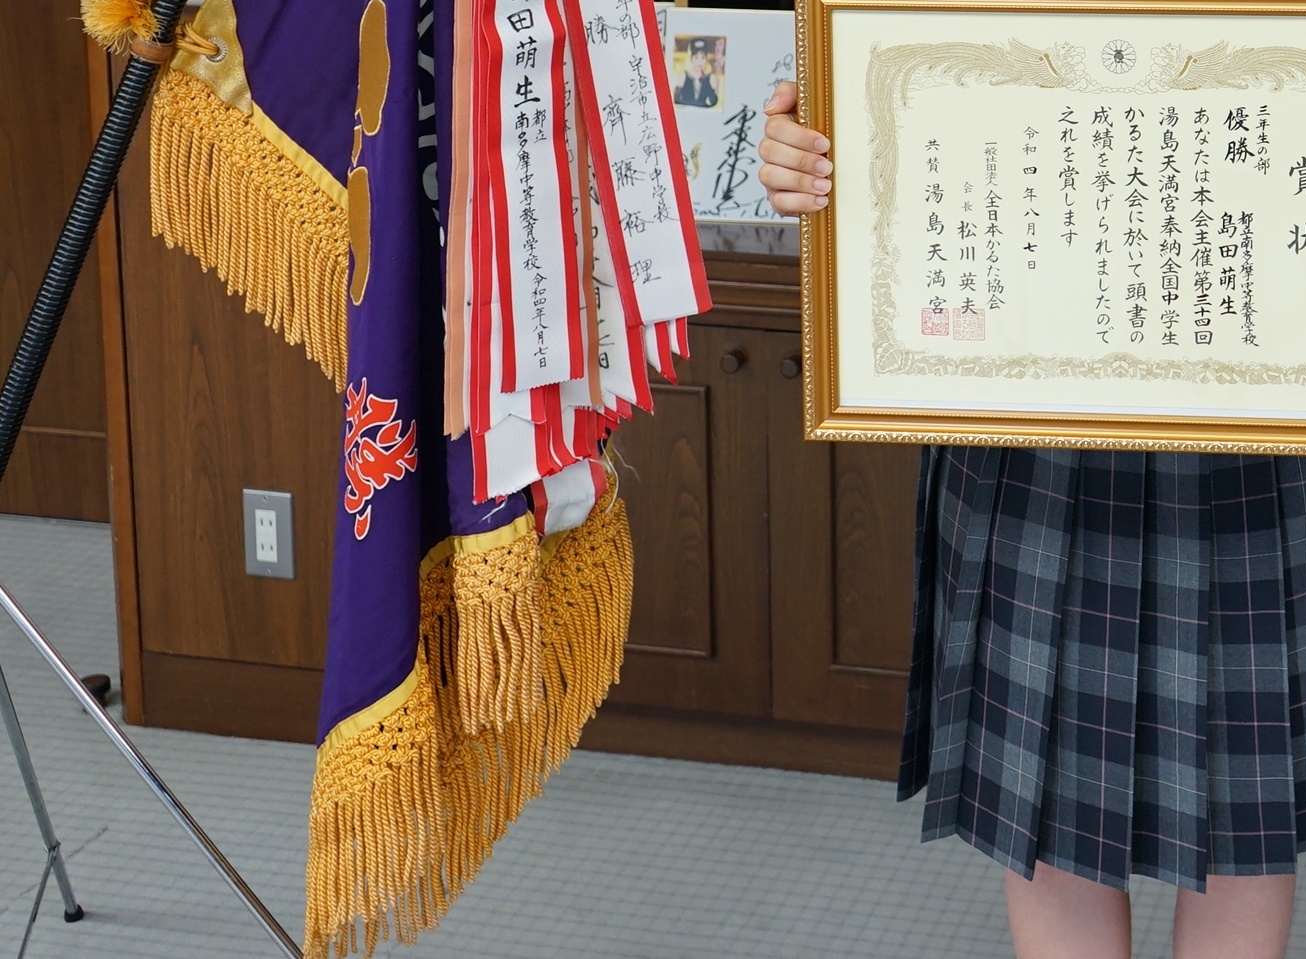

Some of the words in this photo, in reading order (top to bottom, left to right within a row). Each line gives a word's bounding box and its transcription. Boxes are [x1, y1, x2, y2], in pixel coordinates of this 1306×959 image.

[532, 108, 547, 144] 都立
[924, 138, 941, 174] 共賛
[1057, 105, 1081, 248] 之れを賞します
[1222, 106, 1255, 164] 優勝
[1252, 104, 1271, 176] 三年生の部
[924, 183, 949, 315] 湯島天満宮
[961, 181, 974, 212] 会長
[984, 189, 1006, 310] 全日本かるた協会
[1021, 126, 1040, 270] 令和四年八月七日
[1090, 105, 1117, 344] 成績を挙げられましたので
[1123, 106, 1149, 344] かるた大会に於いて頭書の
[1158, 106, 1183, 346] 湯島天満宮奉納全国中学生
[1189, 107, 1215, 347] あなたは本会主催第三十四回
[530, 272, 549, 369] 令和四年八月七日
[956, 220, 979, 315] 松川英夫
[1217, 210, 1239, 316] 島田萌生
[1238, 210, 1259, 347] 都立南多摩中等教育学校
